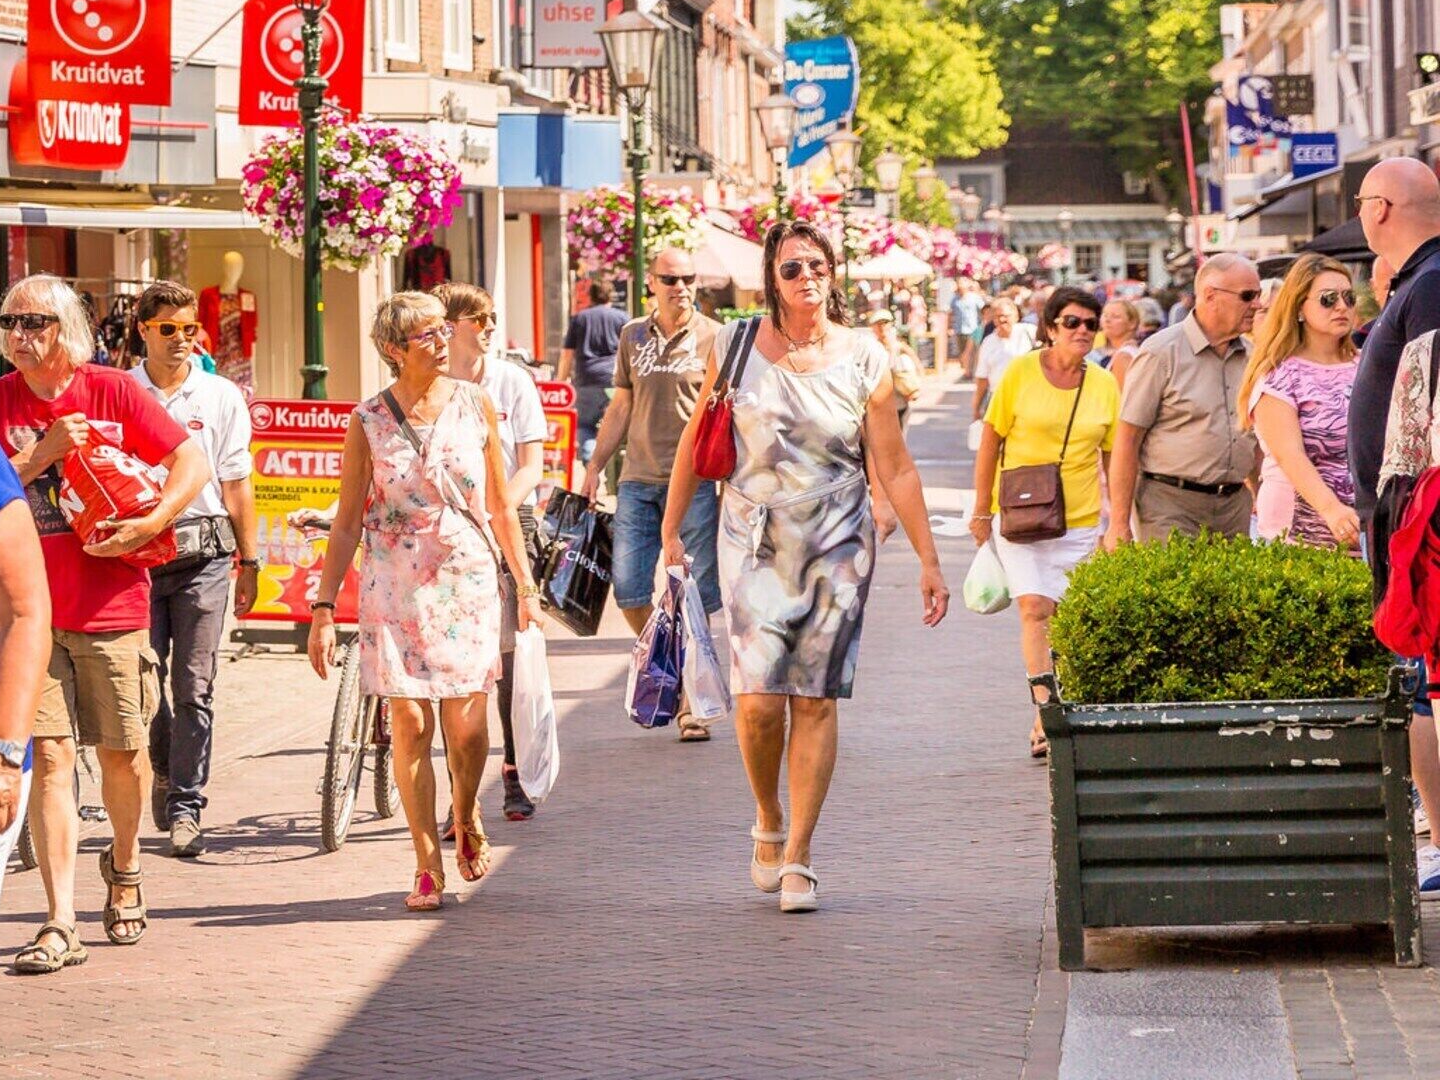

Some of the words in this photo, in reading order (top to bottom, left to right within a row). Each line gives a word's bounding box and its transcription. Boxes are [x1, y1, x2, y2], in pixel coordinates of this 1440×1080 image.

[543, 2, 595, 22] uhse
[51, 60, 145, 86] Kruidvat
[275, 407, 351, 429] Kruidva
[262, 451, 342, 476] ACTIE
